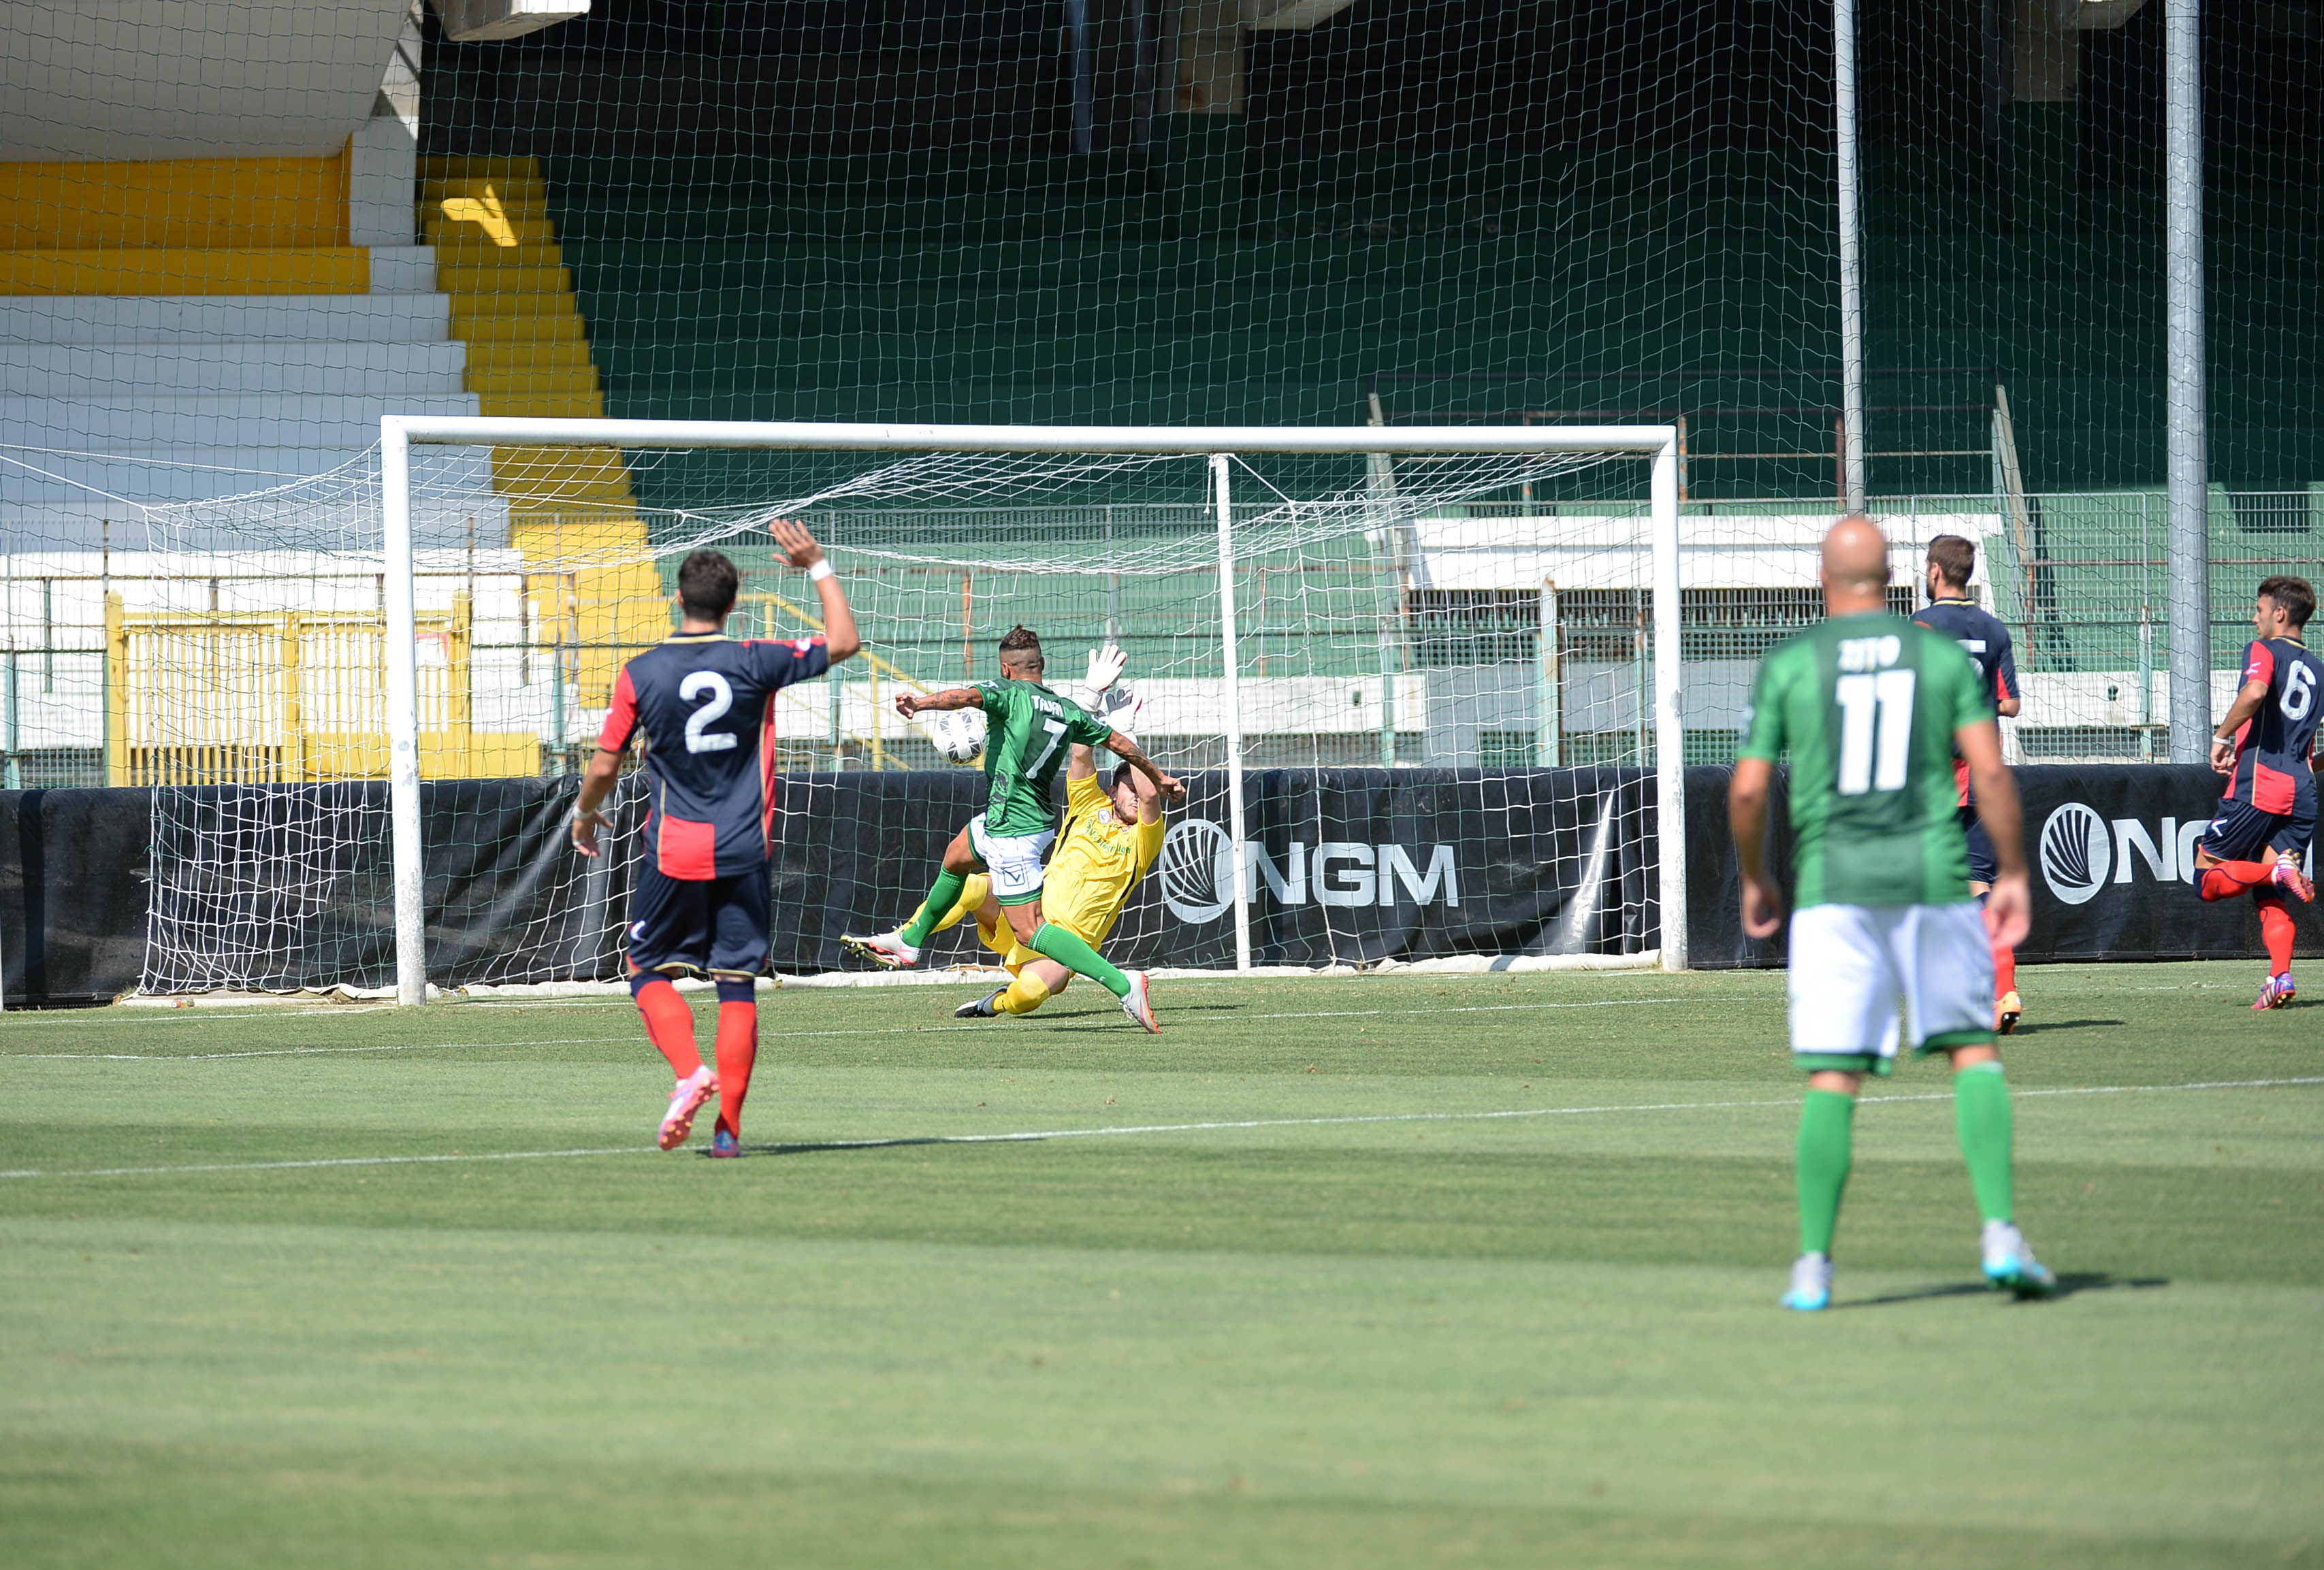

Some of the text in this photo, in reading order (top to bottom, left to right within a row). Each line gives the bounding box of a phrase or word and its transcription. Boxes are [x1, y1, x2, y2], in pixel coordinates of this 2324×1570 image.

[679, 670, 737, 754] 2
[2279, 659, 2317, 721] 6
[1025, 717, 1067, 779] 7
[1836, 668, 1916, 796] 11
[1244, 840, 1459, 907] NGM
